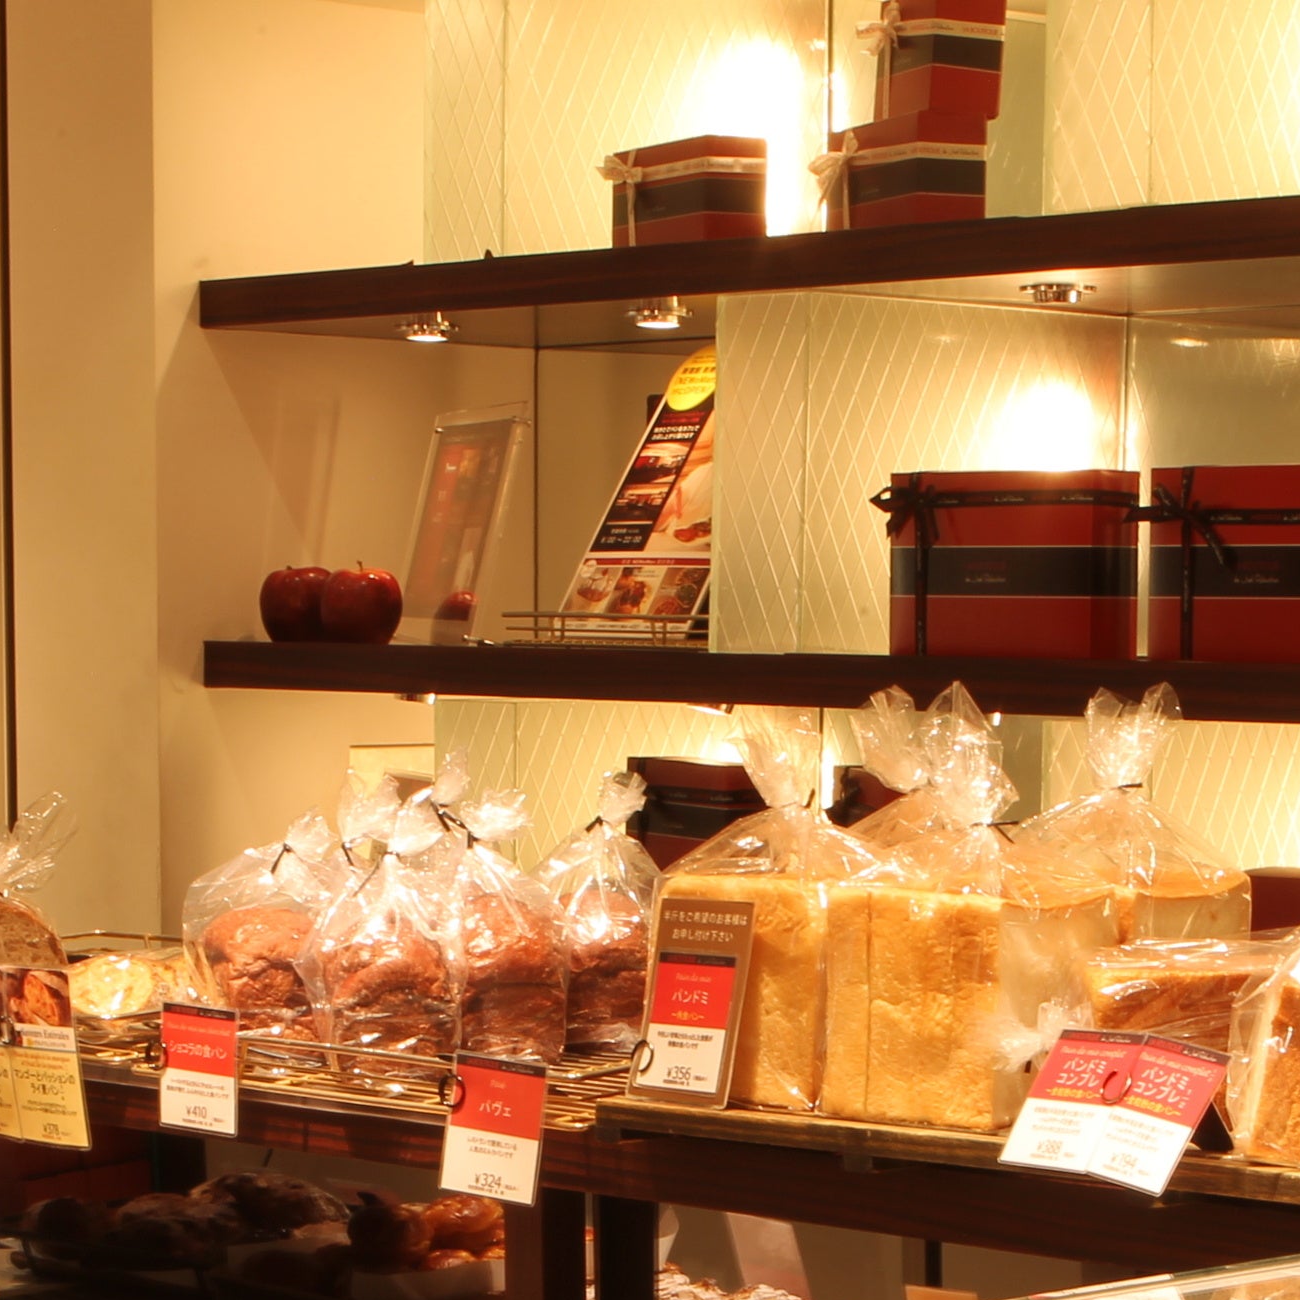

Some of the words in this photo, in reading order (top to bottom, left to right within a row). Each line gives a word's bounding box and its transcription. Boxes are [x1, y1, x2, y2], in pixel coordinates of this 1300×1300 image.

[672, 990, 709, 1005] パンドミ
[667, 1066, 691, 1080] ¥356
[1064, 1058, 1107, 1073] パンドミ
[1056, 1073, 1099, 1087] コンプレ
[1141, 1067, 1189, 1090] パンドミ
[1134, 1081, 1180, 1102] コンプレ
[479, 1101, 512, 1117] パヴェ
[475, 1173, 501, 1188] ¥324
